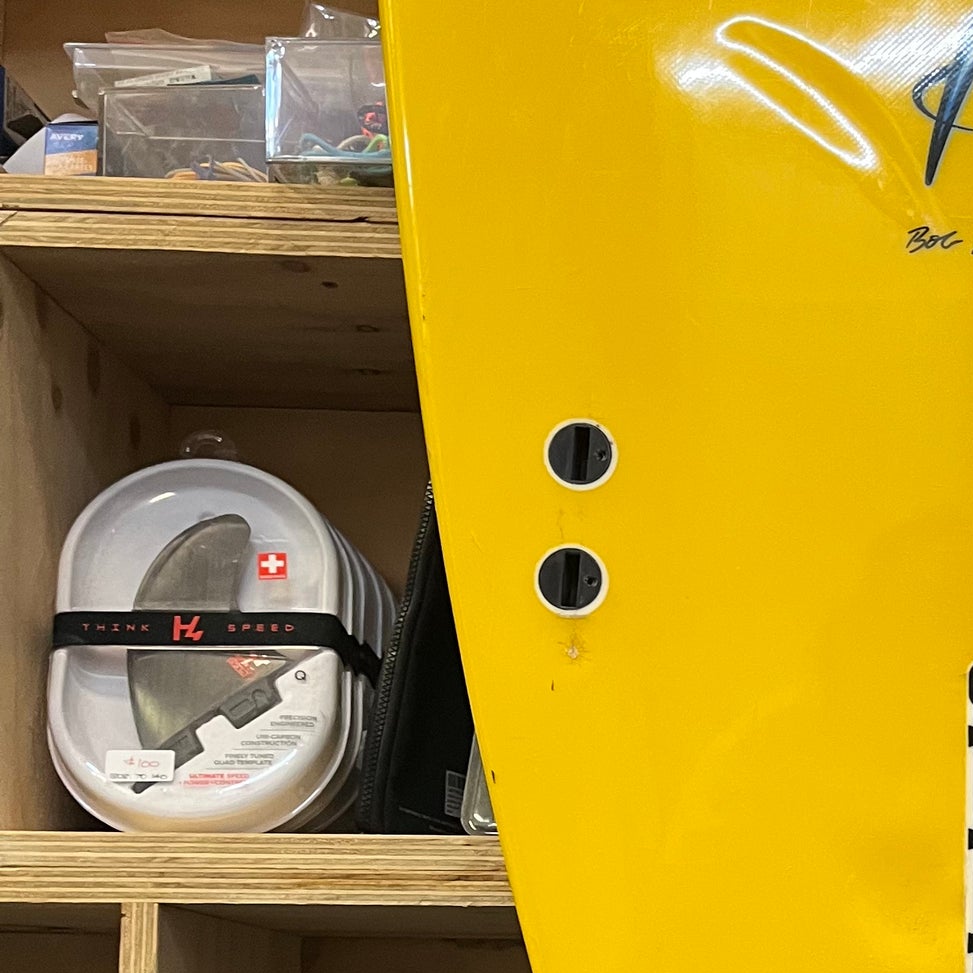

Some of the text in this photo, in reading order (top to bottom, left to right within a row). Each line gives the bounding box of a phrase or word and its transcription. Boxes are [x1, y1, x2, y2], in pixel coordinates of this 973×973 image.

[50, 133, 84, 141] AVERY
[82, 623, 150, 632] THINK
[227, 623, 295, 632] SPEED
